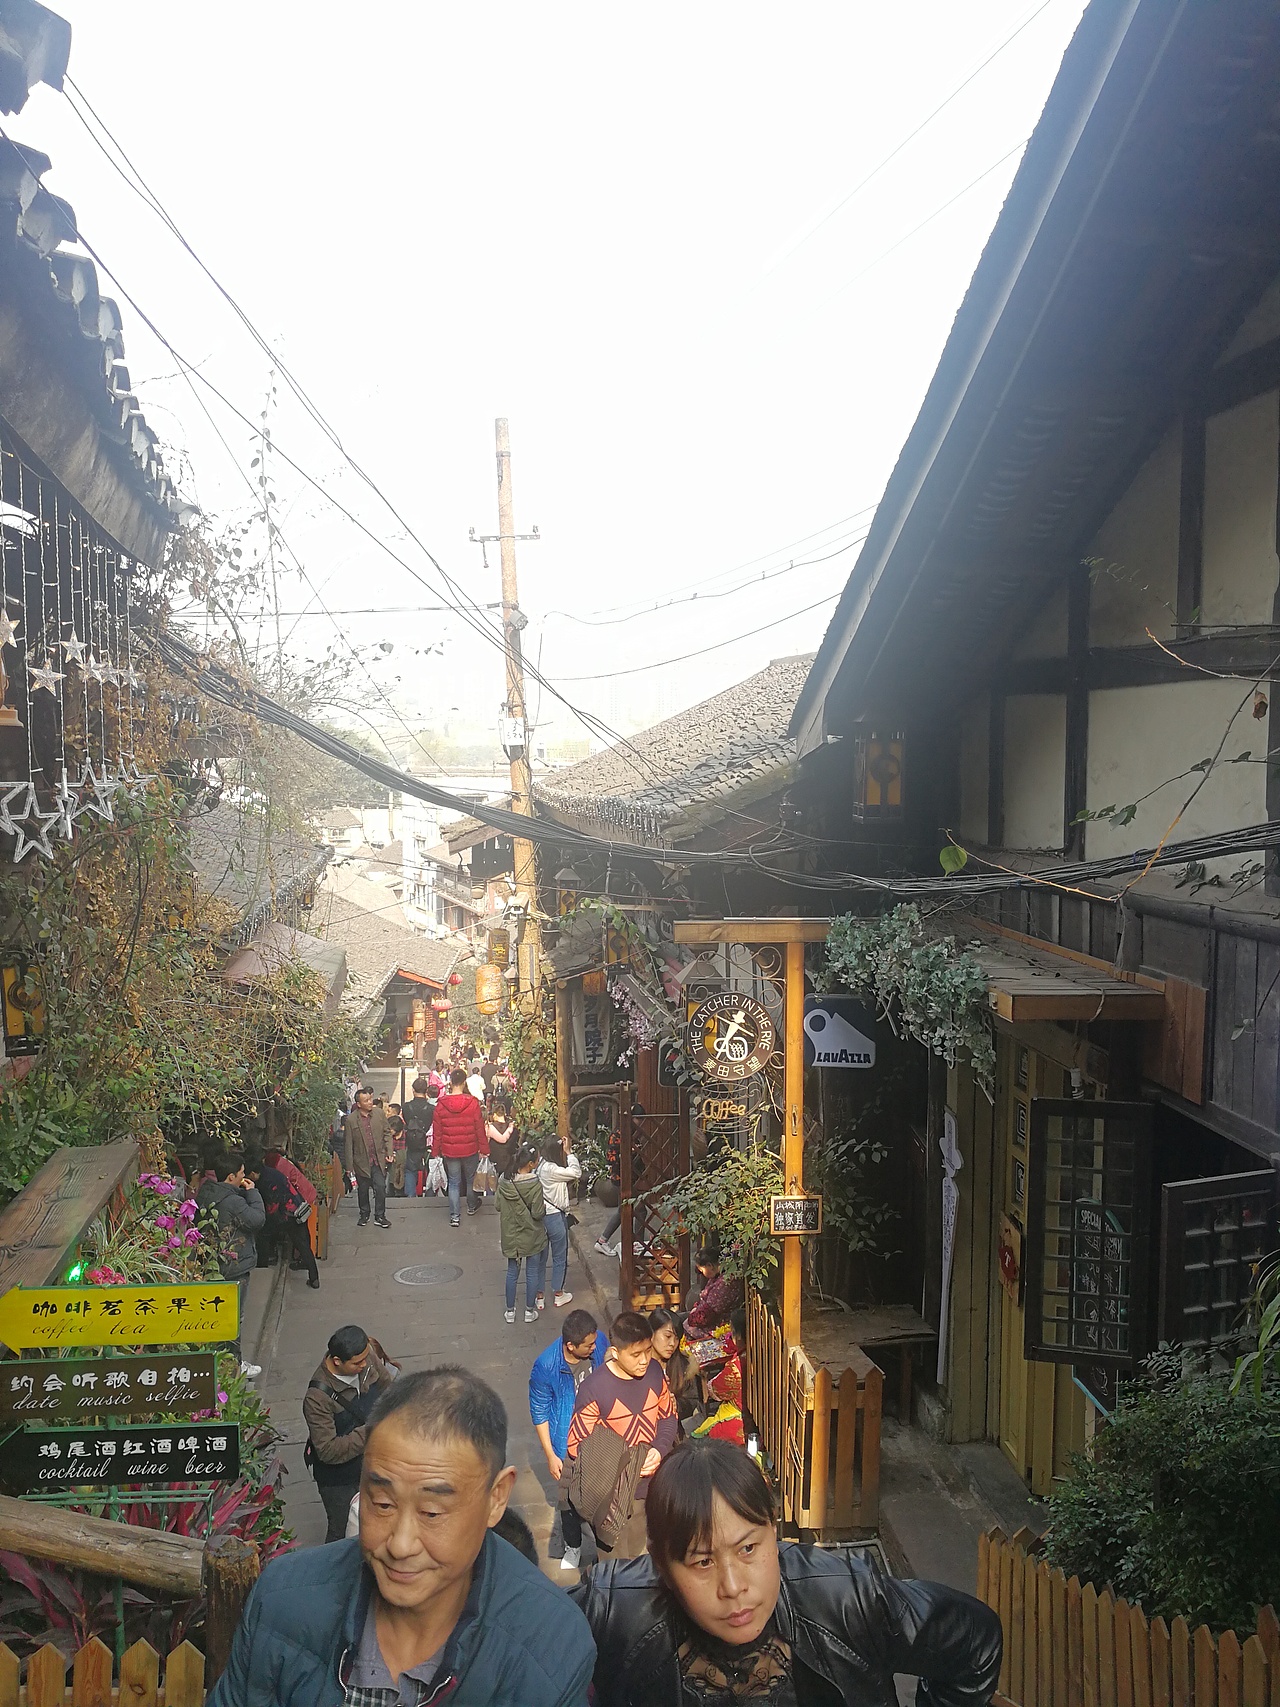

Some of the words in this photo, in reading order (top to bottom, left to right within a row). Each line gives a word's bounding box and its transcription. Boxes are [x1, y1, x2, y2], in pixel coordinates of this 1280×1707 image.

[693, 994, 739, 1028] CATCHER
[741, 997, 755, 1012] IN
[752, 1006, 772, 1030] THE
[690, 1031, 704, 1054] THE
[758, 1030, 772, 1051] RYE
[703, 1055, 762, 1078] 麦田守望
[816, 1048, 872, 1064] LAVAZZA
[31, 1296, 226, 1318] 咖啡茗茶果汁
[32, 1320, 88, 1339] coffee
[110, 1321, 150, 1335] tea
[170, 1317, 221, 1337] juice
[12, 1393, 62, 1410] date
[77, 1391, 134, 1407] music
[145, 1384, 201, 1406] selfie
[37, 1435, 228, 1459] 鸡尾酒红酒啤酒
[38, 1457, 112, 1480] cocktail
[127, 1460, 170, 1475] wine
[184, 1455, 227, 1475] beer
